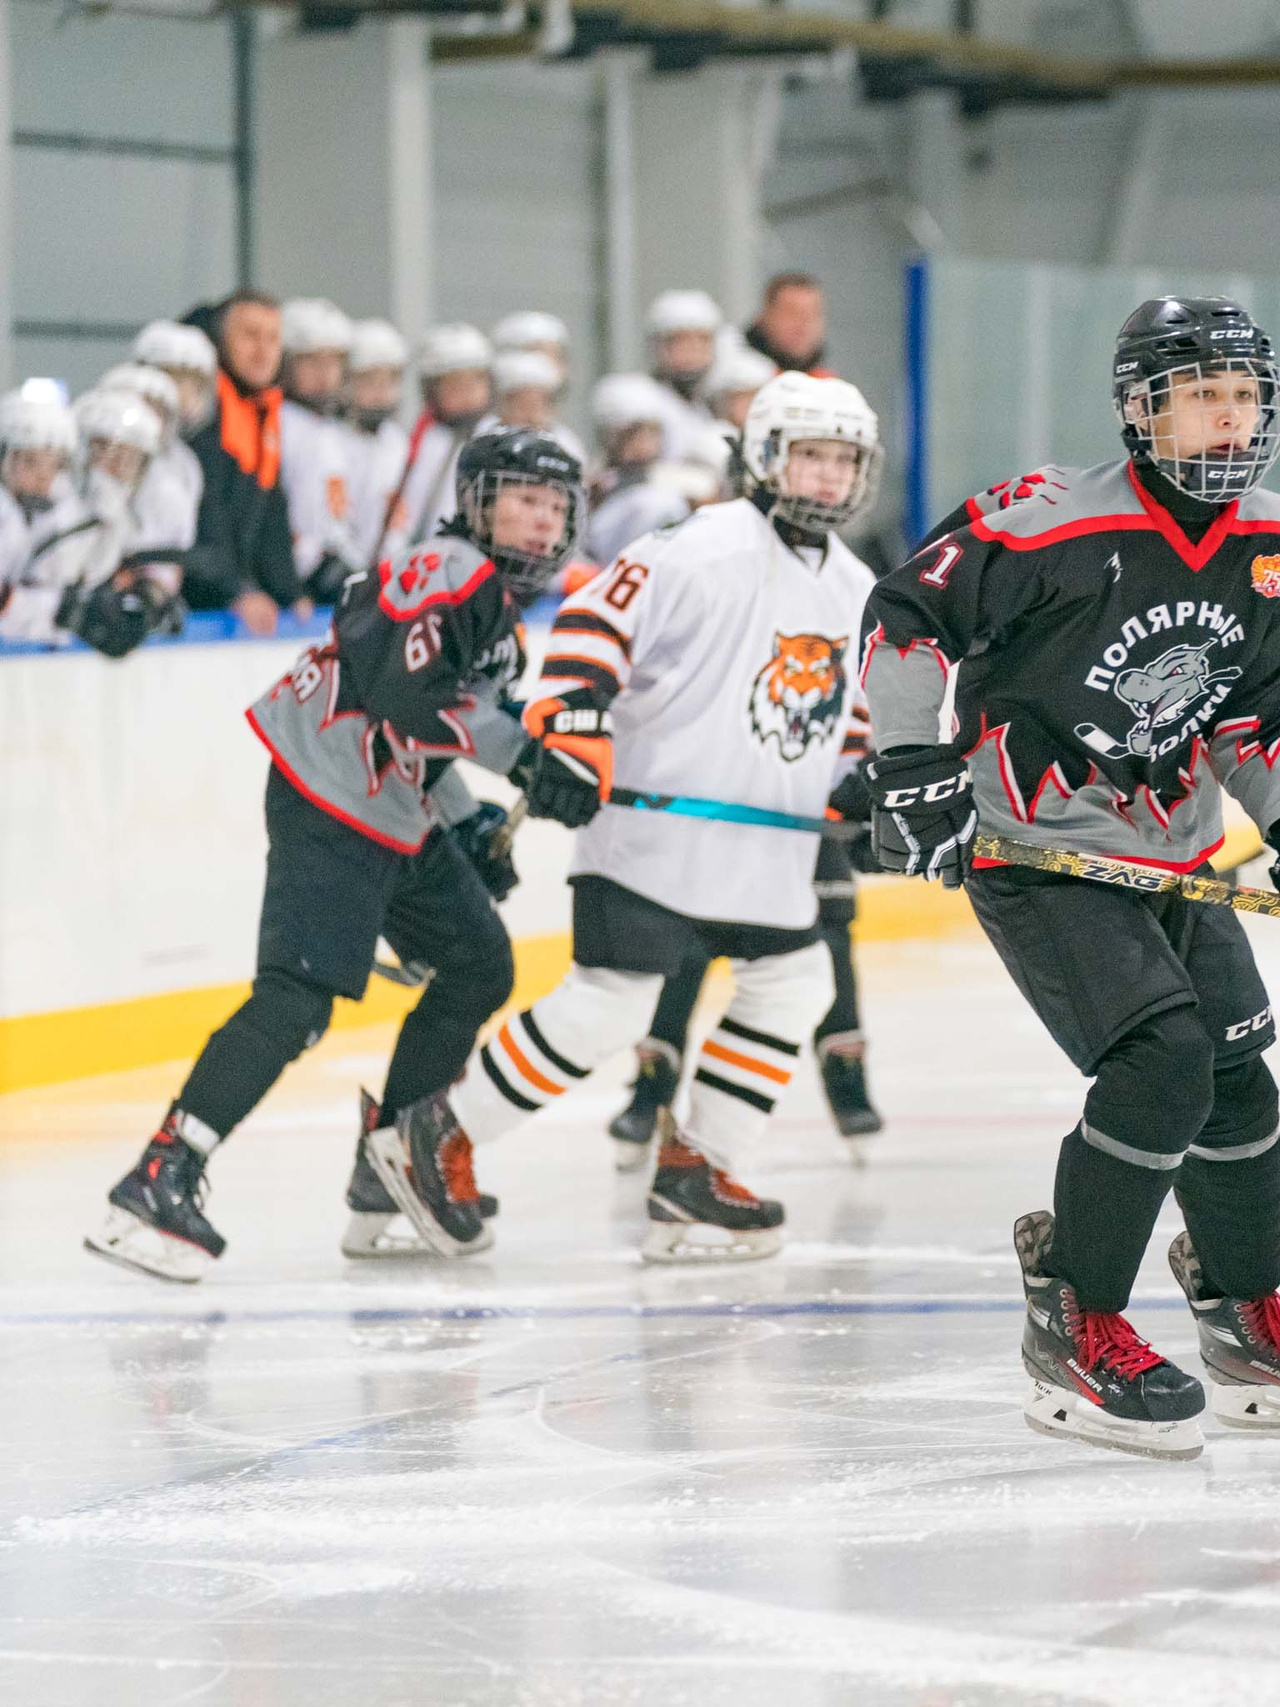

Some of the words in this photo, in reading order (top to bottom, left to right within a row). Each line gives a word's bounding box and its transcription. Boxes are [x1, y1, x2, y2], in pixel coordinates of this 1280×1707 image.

[1209, 328, 1255, 340] CCM
[1115, 361, 1139, 374] CCM
[1207, 469, 1249, 480] CCM
[1083, 600, 1246, 692] ПОЛЯРНЫЕ
[1081, 862, 1165, 892] ZAG
[1066, 1357, 1104, 1393] BAUER
